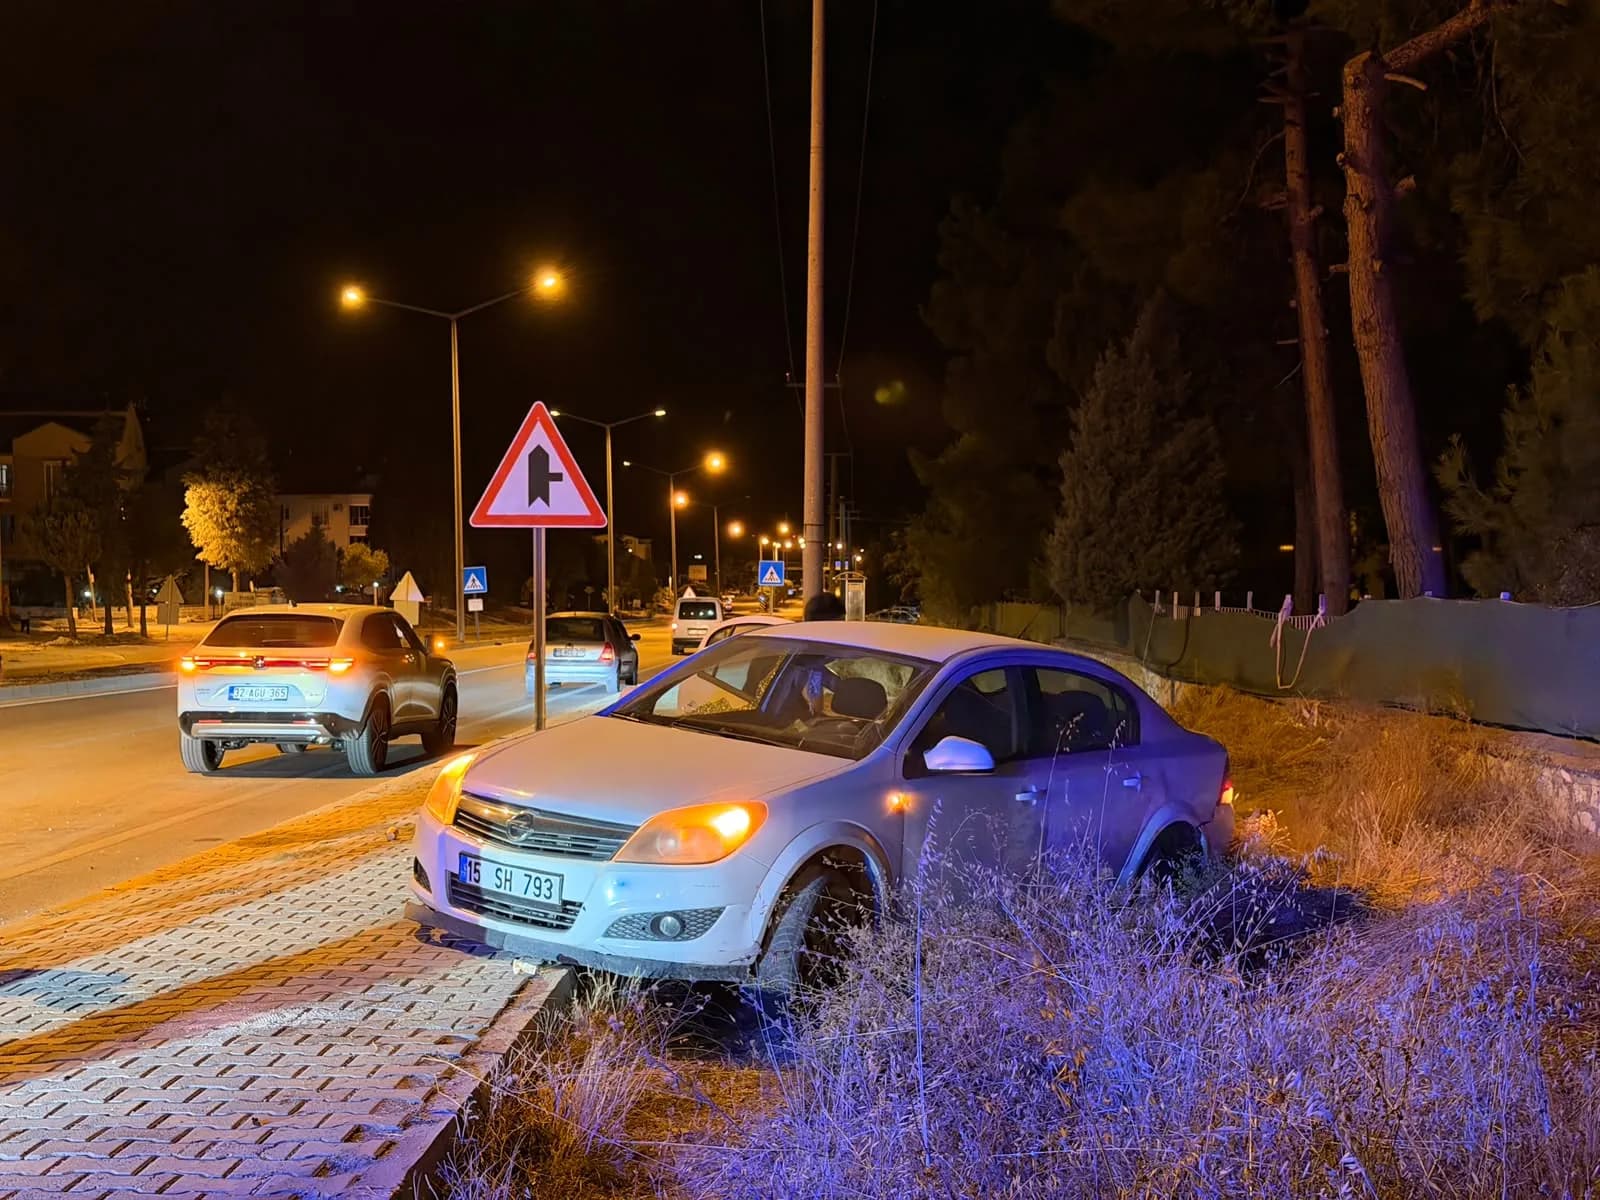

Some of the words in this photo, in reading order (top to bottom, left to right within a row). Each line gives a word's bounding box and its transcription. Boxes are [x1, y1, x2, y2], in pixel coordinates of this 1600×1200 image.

[234, 688, 245, 697] 32
[249, 688, 265, 697] AGU
[270, 688, 286, 698] 365
[468, 861, 482, 884] 15
[495, 867, 513, 892] SH
[523, 873, 553, 900] 793
